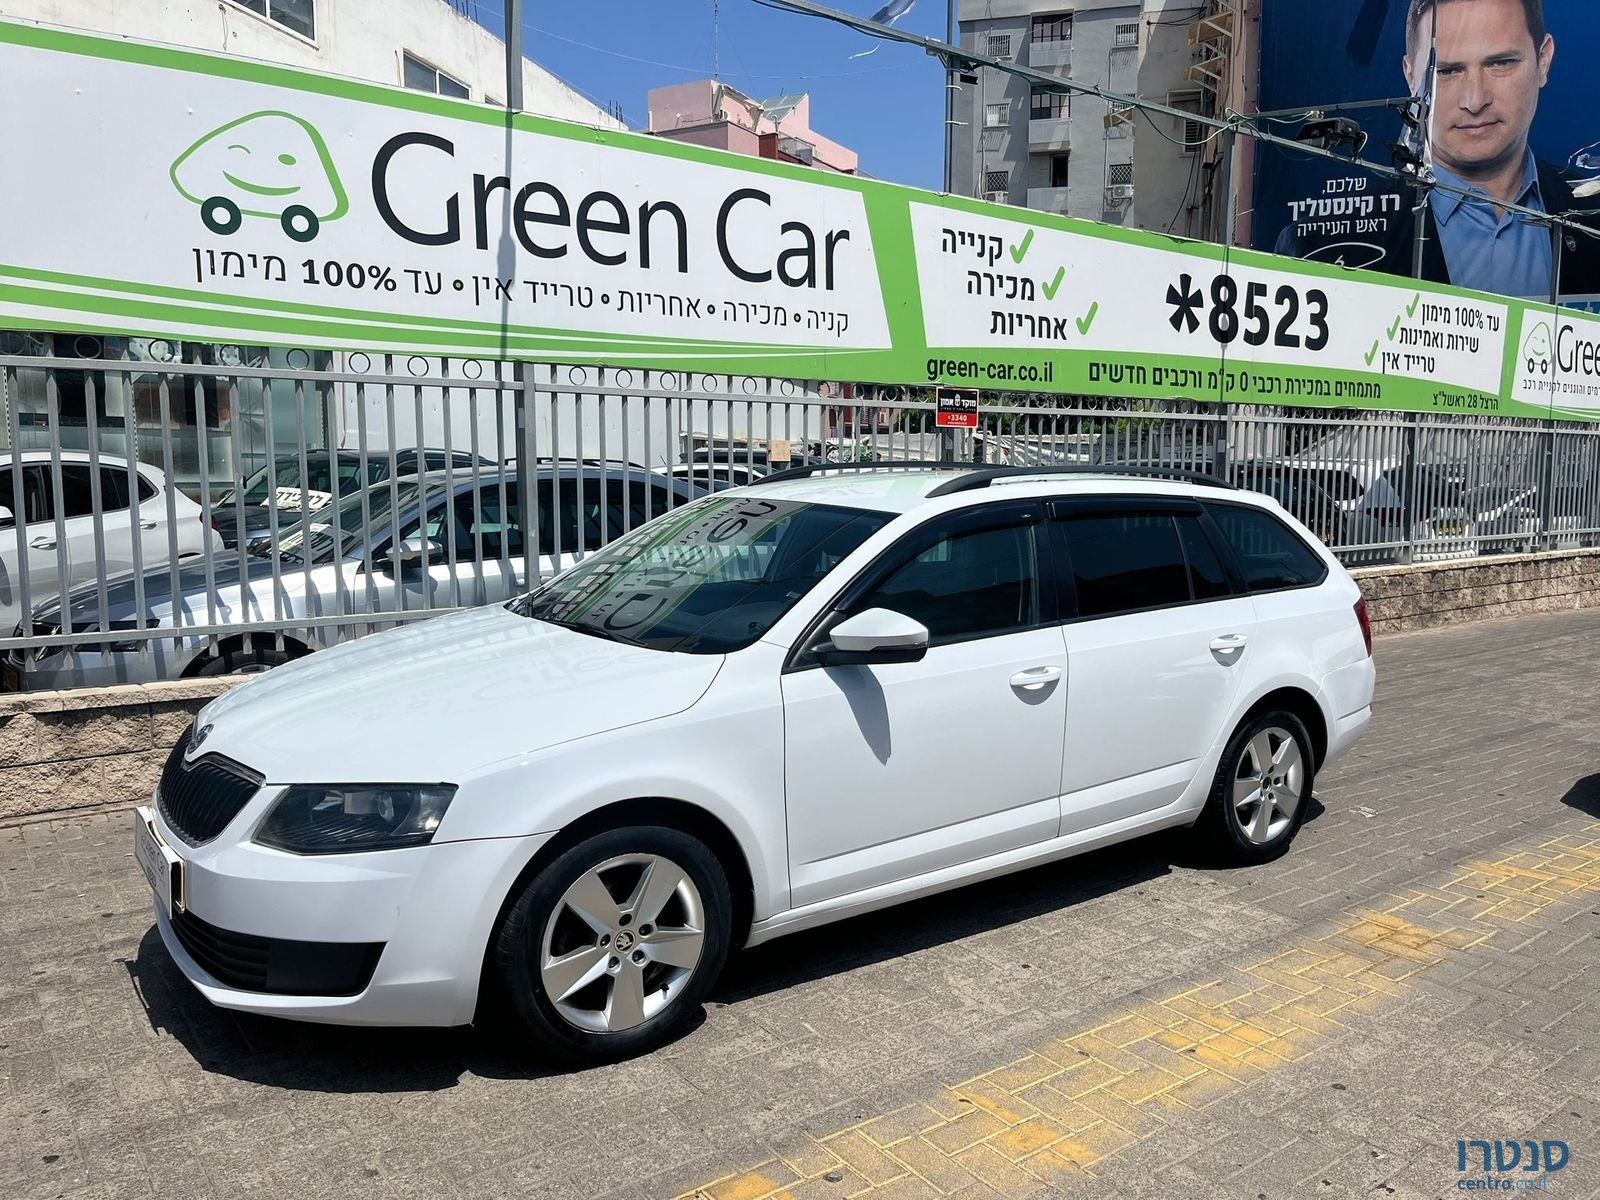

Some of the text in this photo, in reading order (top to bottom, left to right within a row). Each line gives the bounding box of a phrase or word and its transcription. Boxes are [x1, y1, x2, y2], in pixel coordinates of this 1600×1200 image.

[1322, 177, 1366, 194] שלכם,
[372, 131, 850, 290] Green Car
[1288, 194, 1400, 221] רז קינסטליך
[1297, 218, 1387, 237] ראש העירייה
[942, 228, 1002, 267] קנייה
[192, 248, 848, 337] קניה מכירה אחריות טרייד אין עד 100% מימון
[967, 270, 1034, 301] מכירה
[990, 310, 1067, 340] אחריות
[1422, 304, 1499, 332] עד 100% מימון
[1400, 327, 1479, 353] שירות ואמינות
[927, 358, 1053, 382] green-car.co.il
[1089, 362, 1147, 385] חדשים
[1382, 352, 1435, 374] טרייד אין
[1153, 367, 1202, 389] ורכבים
[1240, 371, 1248, 392] 0
[1252, 375, 1281, 394] רכבי
[1285, 377, 1330, 396] במכירת
[1523, 379, 1536, 391] רכב
[1335, 380, 1381, 399] מתמחים
[1433, 390, 1499, 410] הרצל 28 ראשל"צ
[961, 399, 976, 408] מוקד
